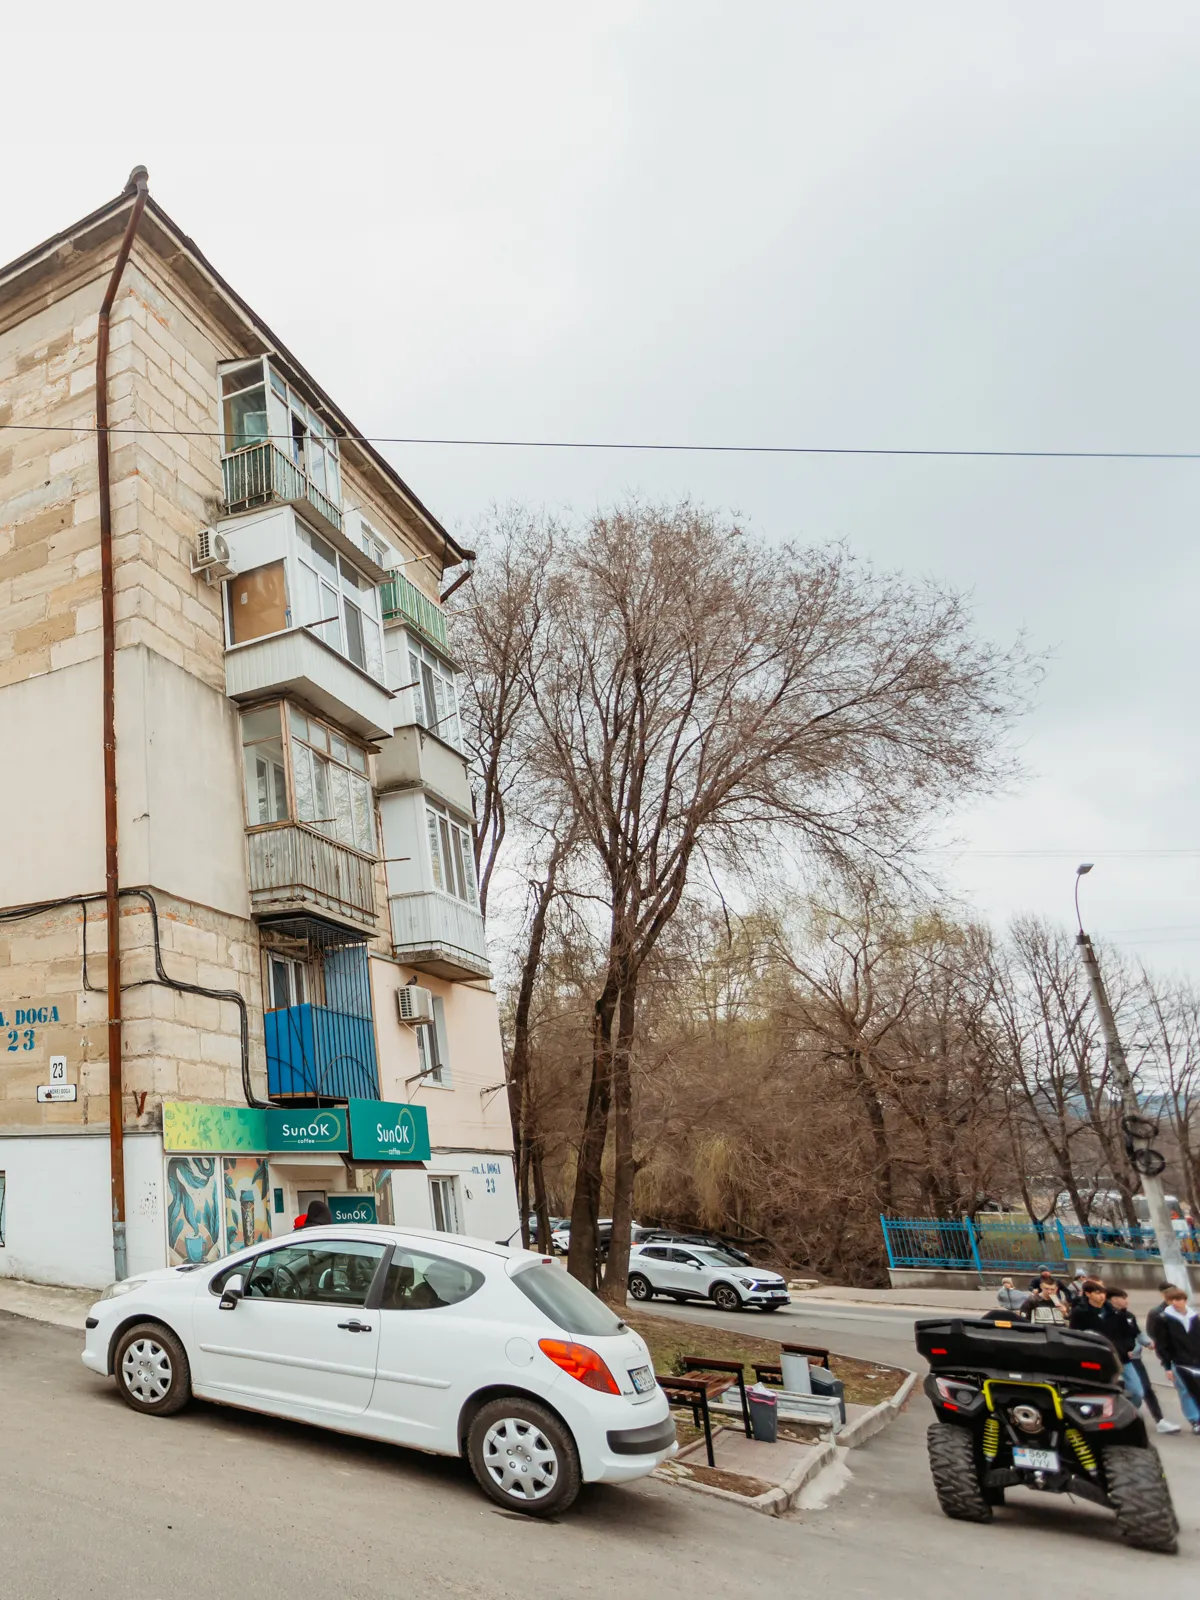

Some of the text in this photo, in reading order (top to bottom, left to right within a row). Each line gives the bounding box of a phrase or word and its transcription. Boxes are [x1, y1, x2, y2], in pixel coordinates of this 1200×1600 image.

[15, 1005, 60, 1026] DOGA
[7, 1029, 36, 1052] 23
[52, 1062, 64, 1079] 23
[282, 1123, 330, 1137] SunOK
[376, 1122, 410, 1144] SunOK
[388, 1147, 401, 1156] coffee
[485, 1178, 496, 1193] 23
[335, 1209, 368, 1220] SunOK
